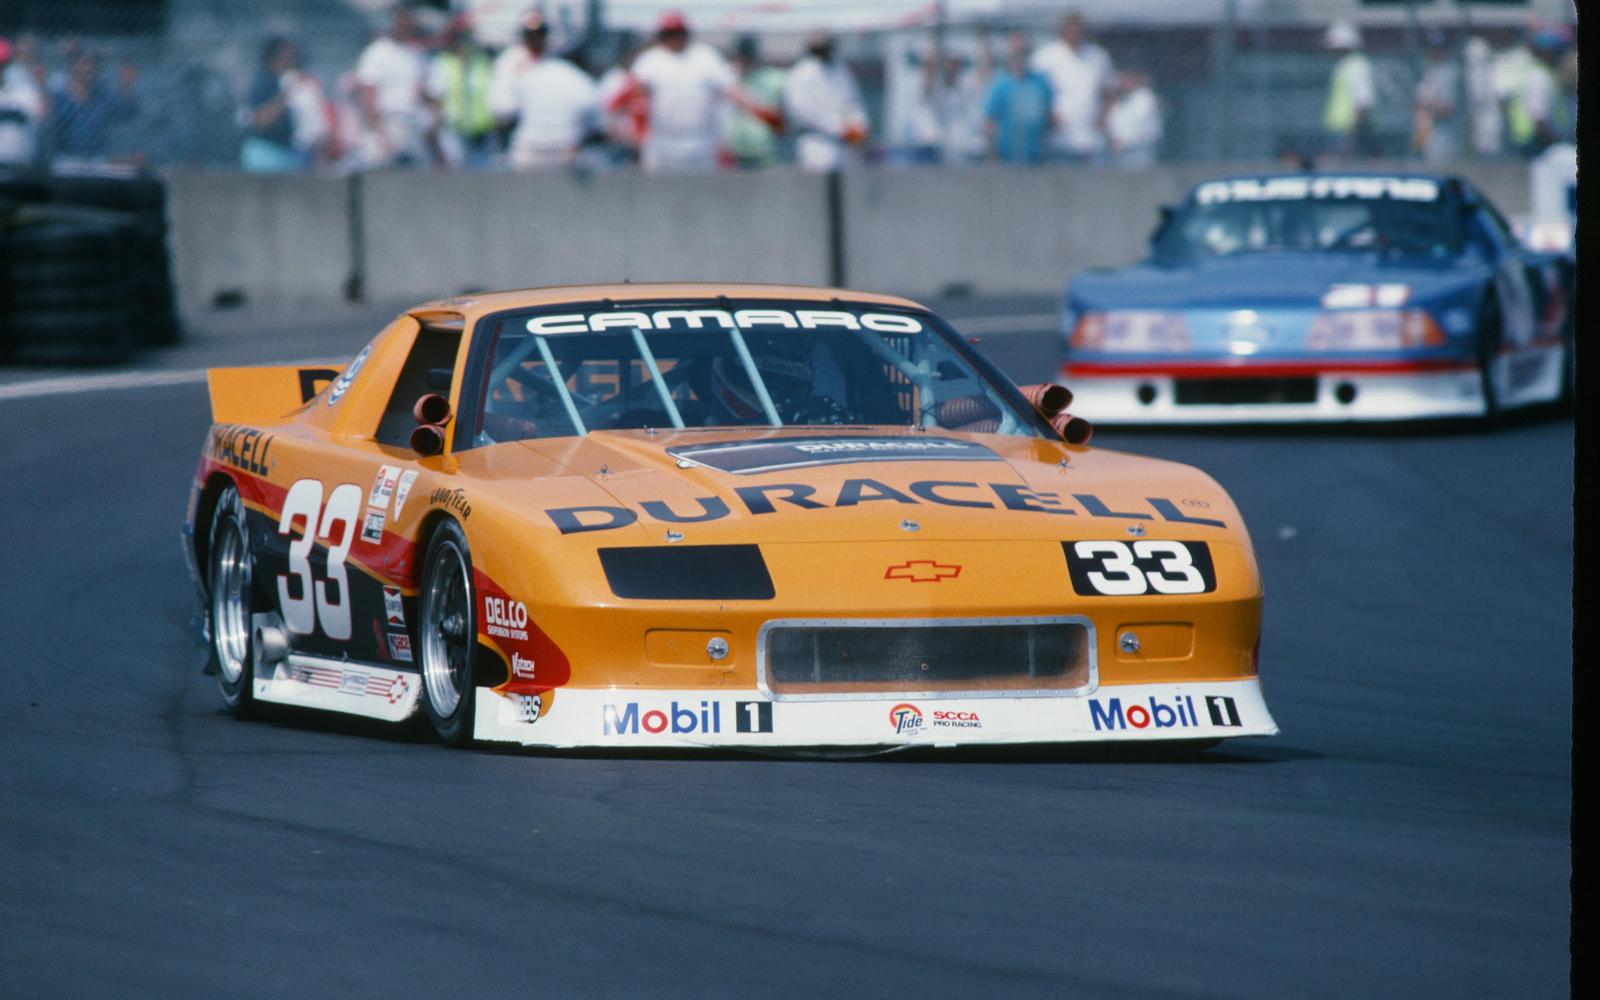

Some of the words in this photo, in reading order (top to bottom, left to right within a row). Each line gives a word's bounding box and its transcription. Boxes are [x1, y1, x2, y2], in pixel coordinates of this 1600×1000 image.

[526, 308, 923, 336] CAMARO
[277, 478, 363, 641] 33
[1074, 540, 1206, 595] 33
[485, 596, 528, 629] DELCO
[603, 701, 720, 735] Mobil
[744, 702, 760, 732] 1
[895, 710, 923, 734] Tide
[933, 711, 980, 721] SCCA
[1088, 696, 1198, 731] Mobil
[1212, 697, 1232, 726] 1
